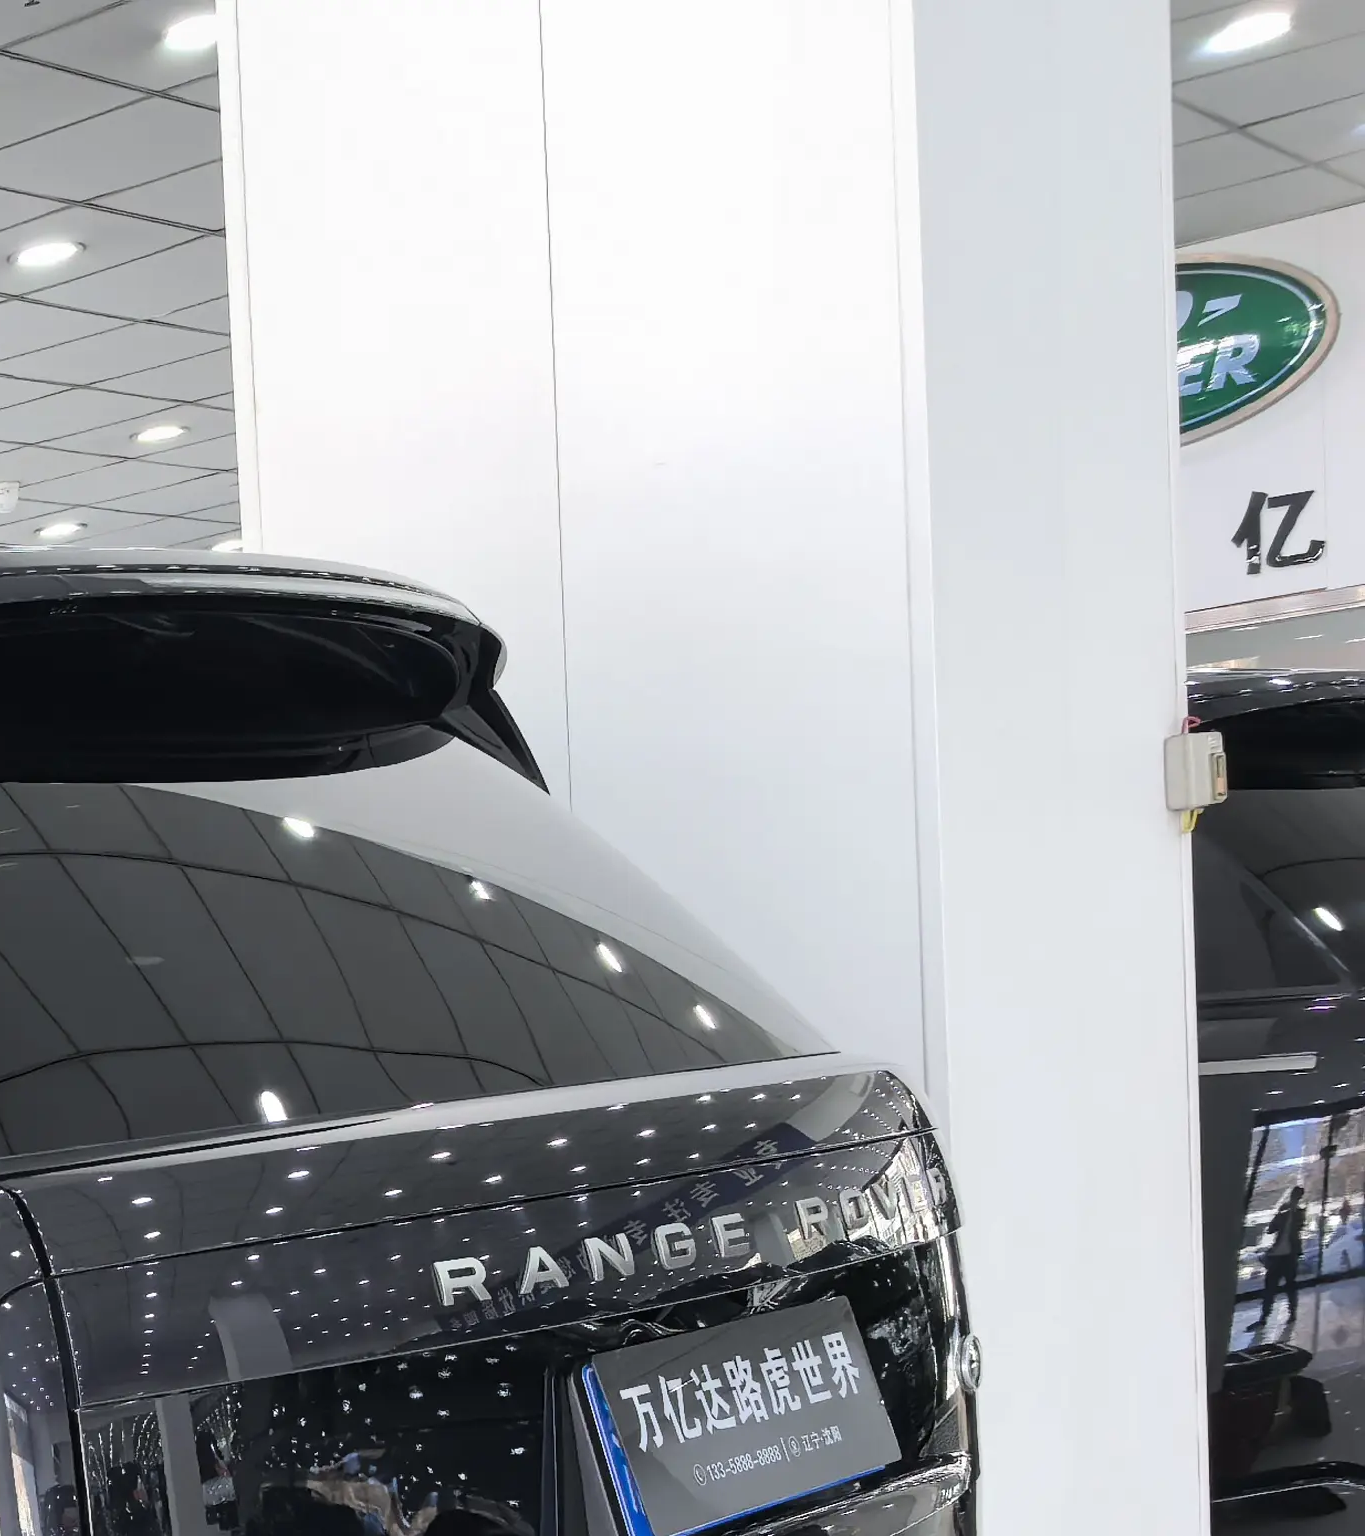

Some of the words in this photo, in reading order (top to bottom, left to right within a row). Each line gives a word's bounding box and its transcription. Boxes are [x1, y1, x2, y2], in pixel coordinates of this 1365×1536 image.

[1231, 490, 1325, 575] 亿
[432, 1212, 752, 1307] RANGE
[620, 1331, 859, 1453] 万亿达路虎世界
